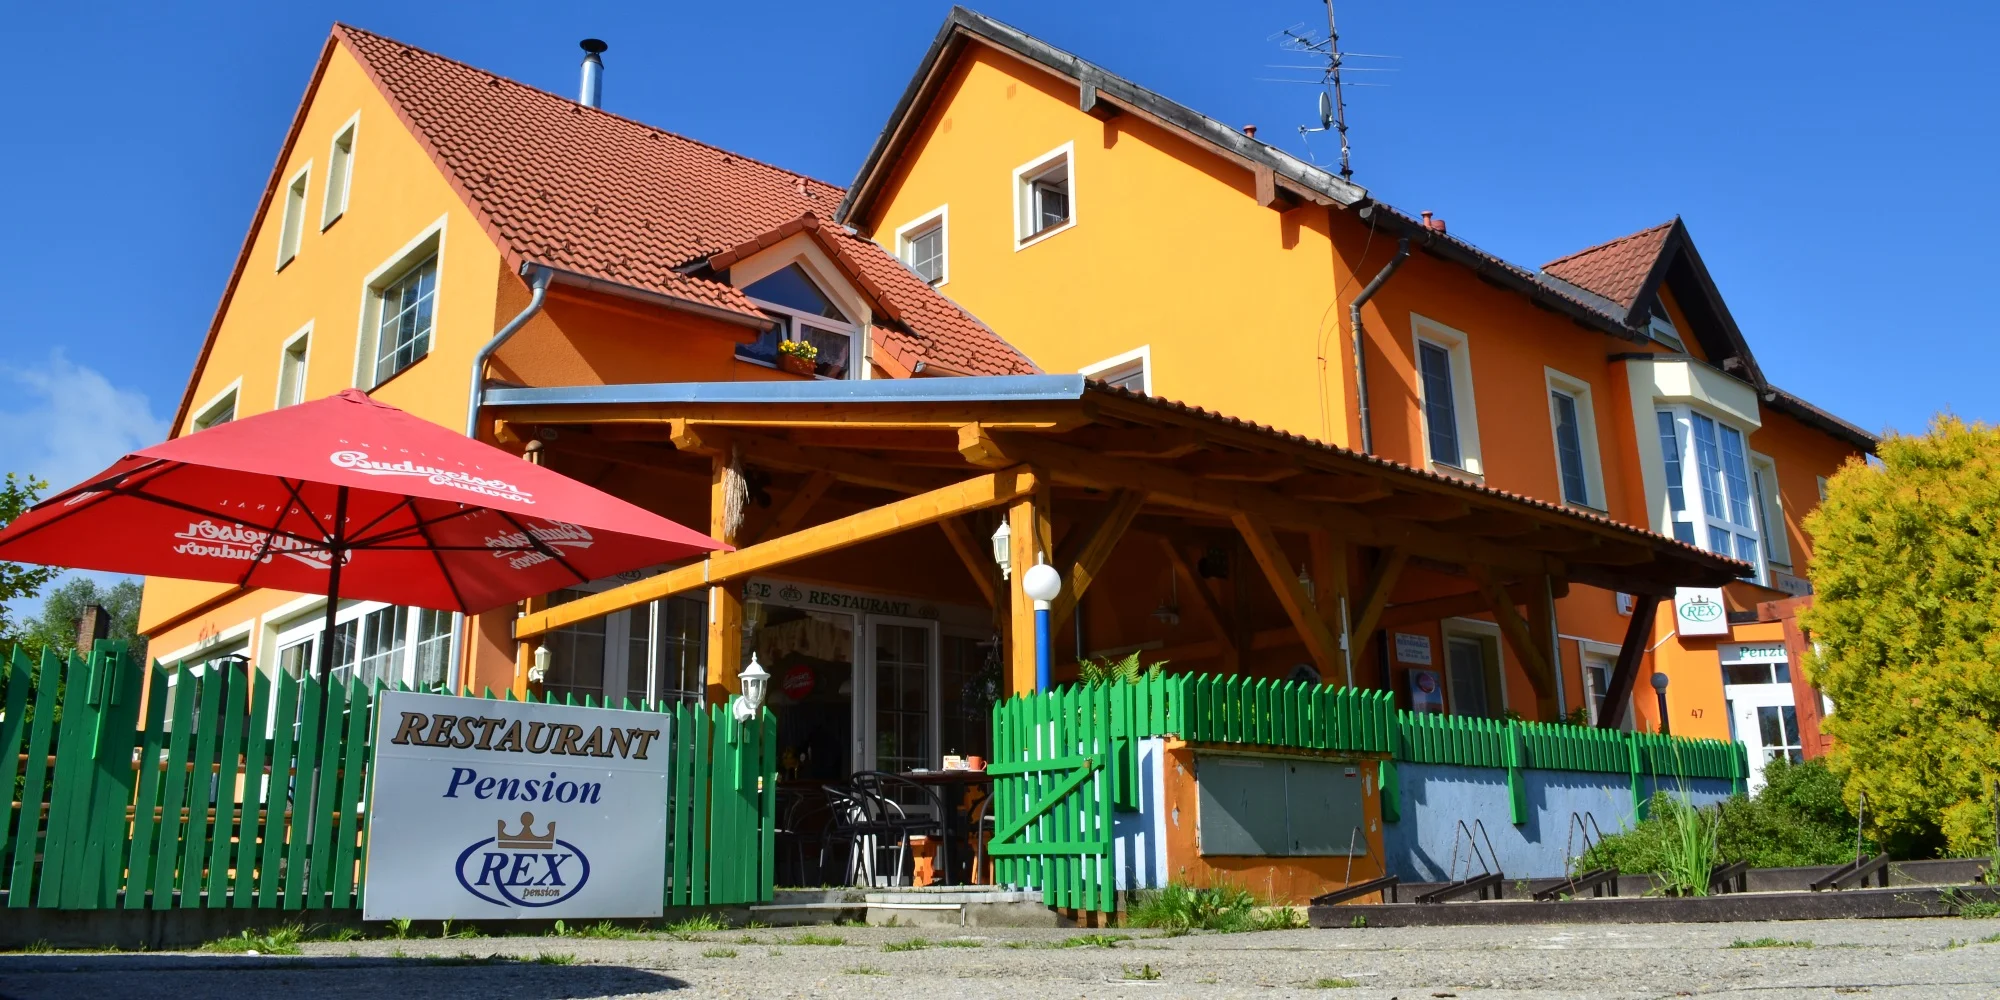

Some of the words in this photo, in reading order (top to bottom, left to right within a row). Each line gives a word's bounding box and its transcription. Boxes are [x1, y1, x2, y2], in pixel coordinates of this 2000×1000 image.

[339, 439, 483, 470] ORIGINAL
[330, 450, 533, 497] Budweiser
[428, 474, 536, 504] Budvar
[808, 590, 911, 616] RESTAURANT
[1687, 605, 1715, 617] REX
[1691, 708, 1703, 719] 47
[391, 711, 660, 760] RESTAURANT
[442, 767, 601, 804] Pension
[474, 852, 573, 886] REX
[521, 886, 560, 900] pension
